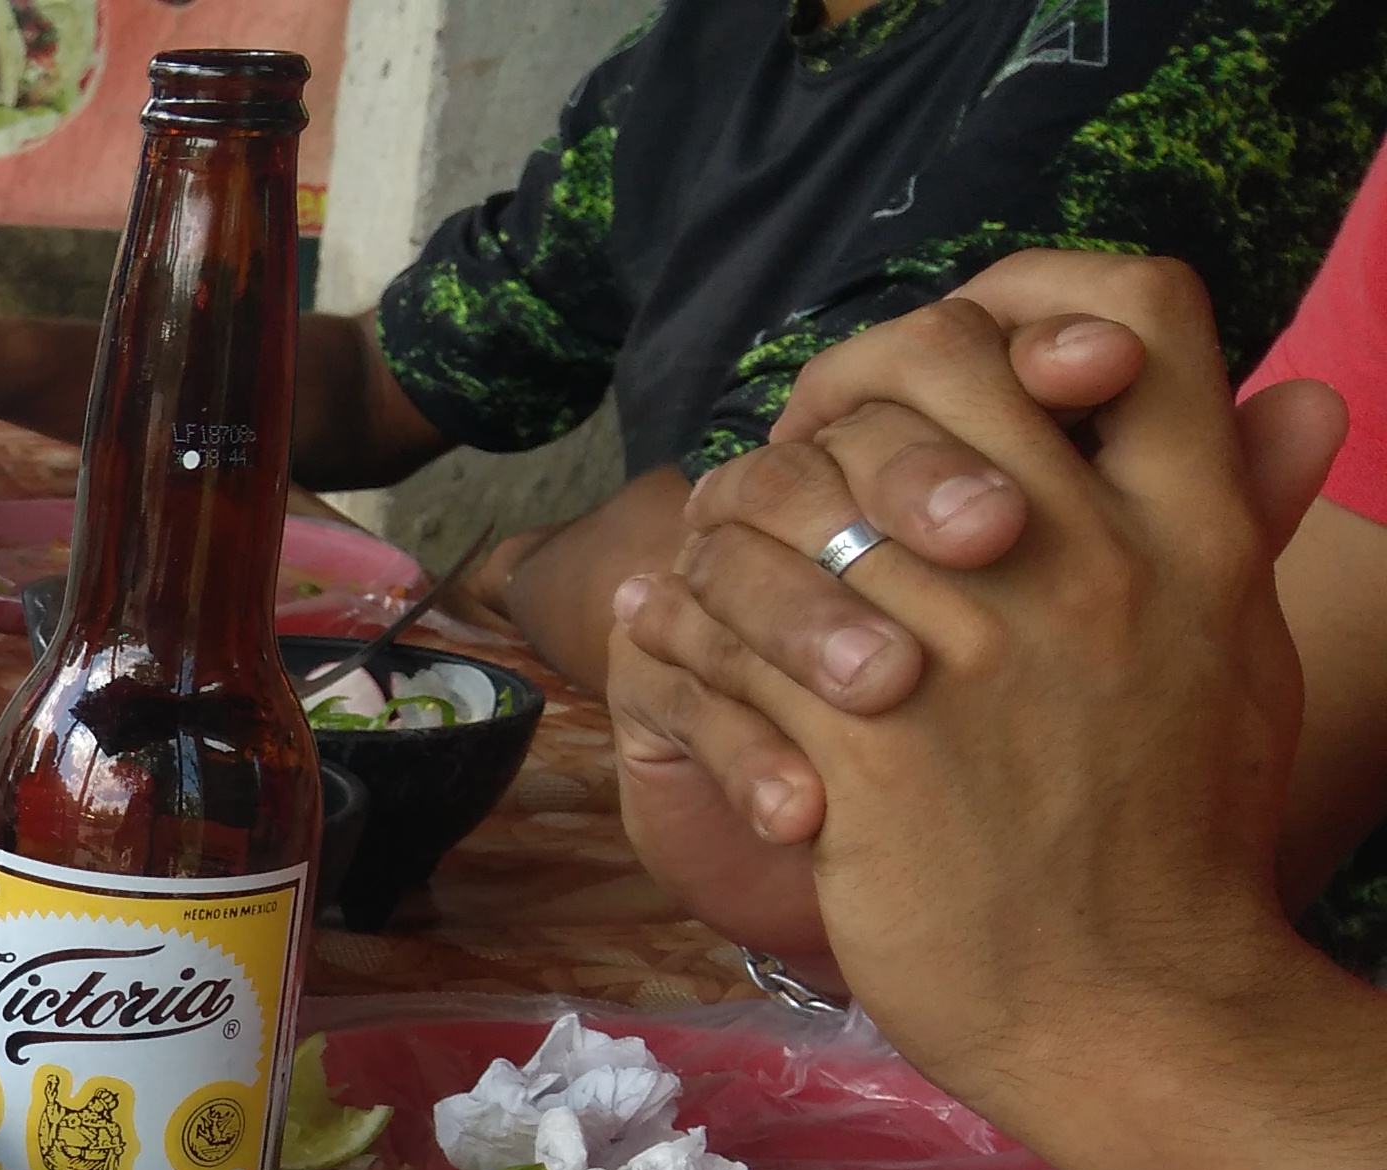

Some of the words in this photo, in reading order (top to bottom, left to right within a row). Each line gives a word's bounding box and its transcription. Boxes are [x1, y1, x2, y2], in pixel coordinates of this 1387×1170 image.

[183, 908, 221, 920] HECHO
[223, 907, 238, 918] EN
[239, 901, 278, 917] MEXICO
